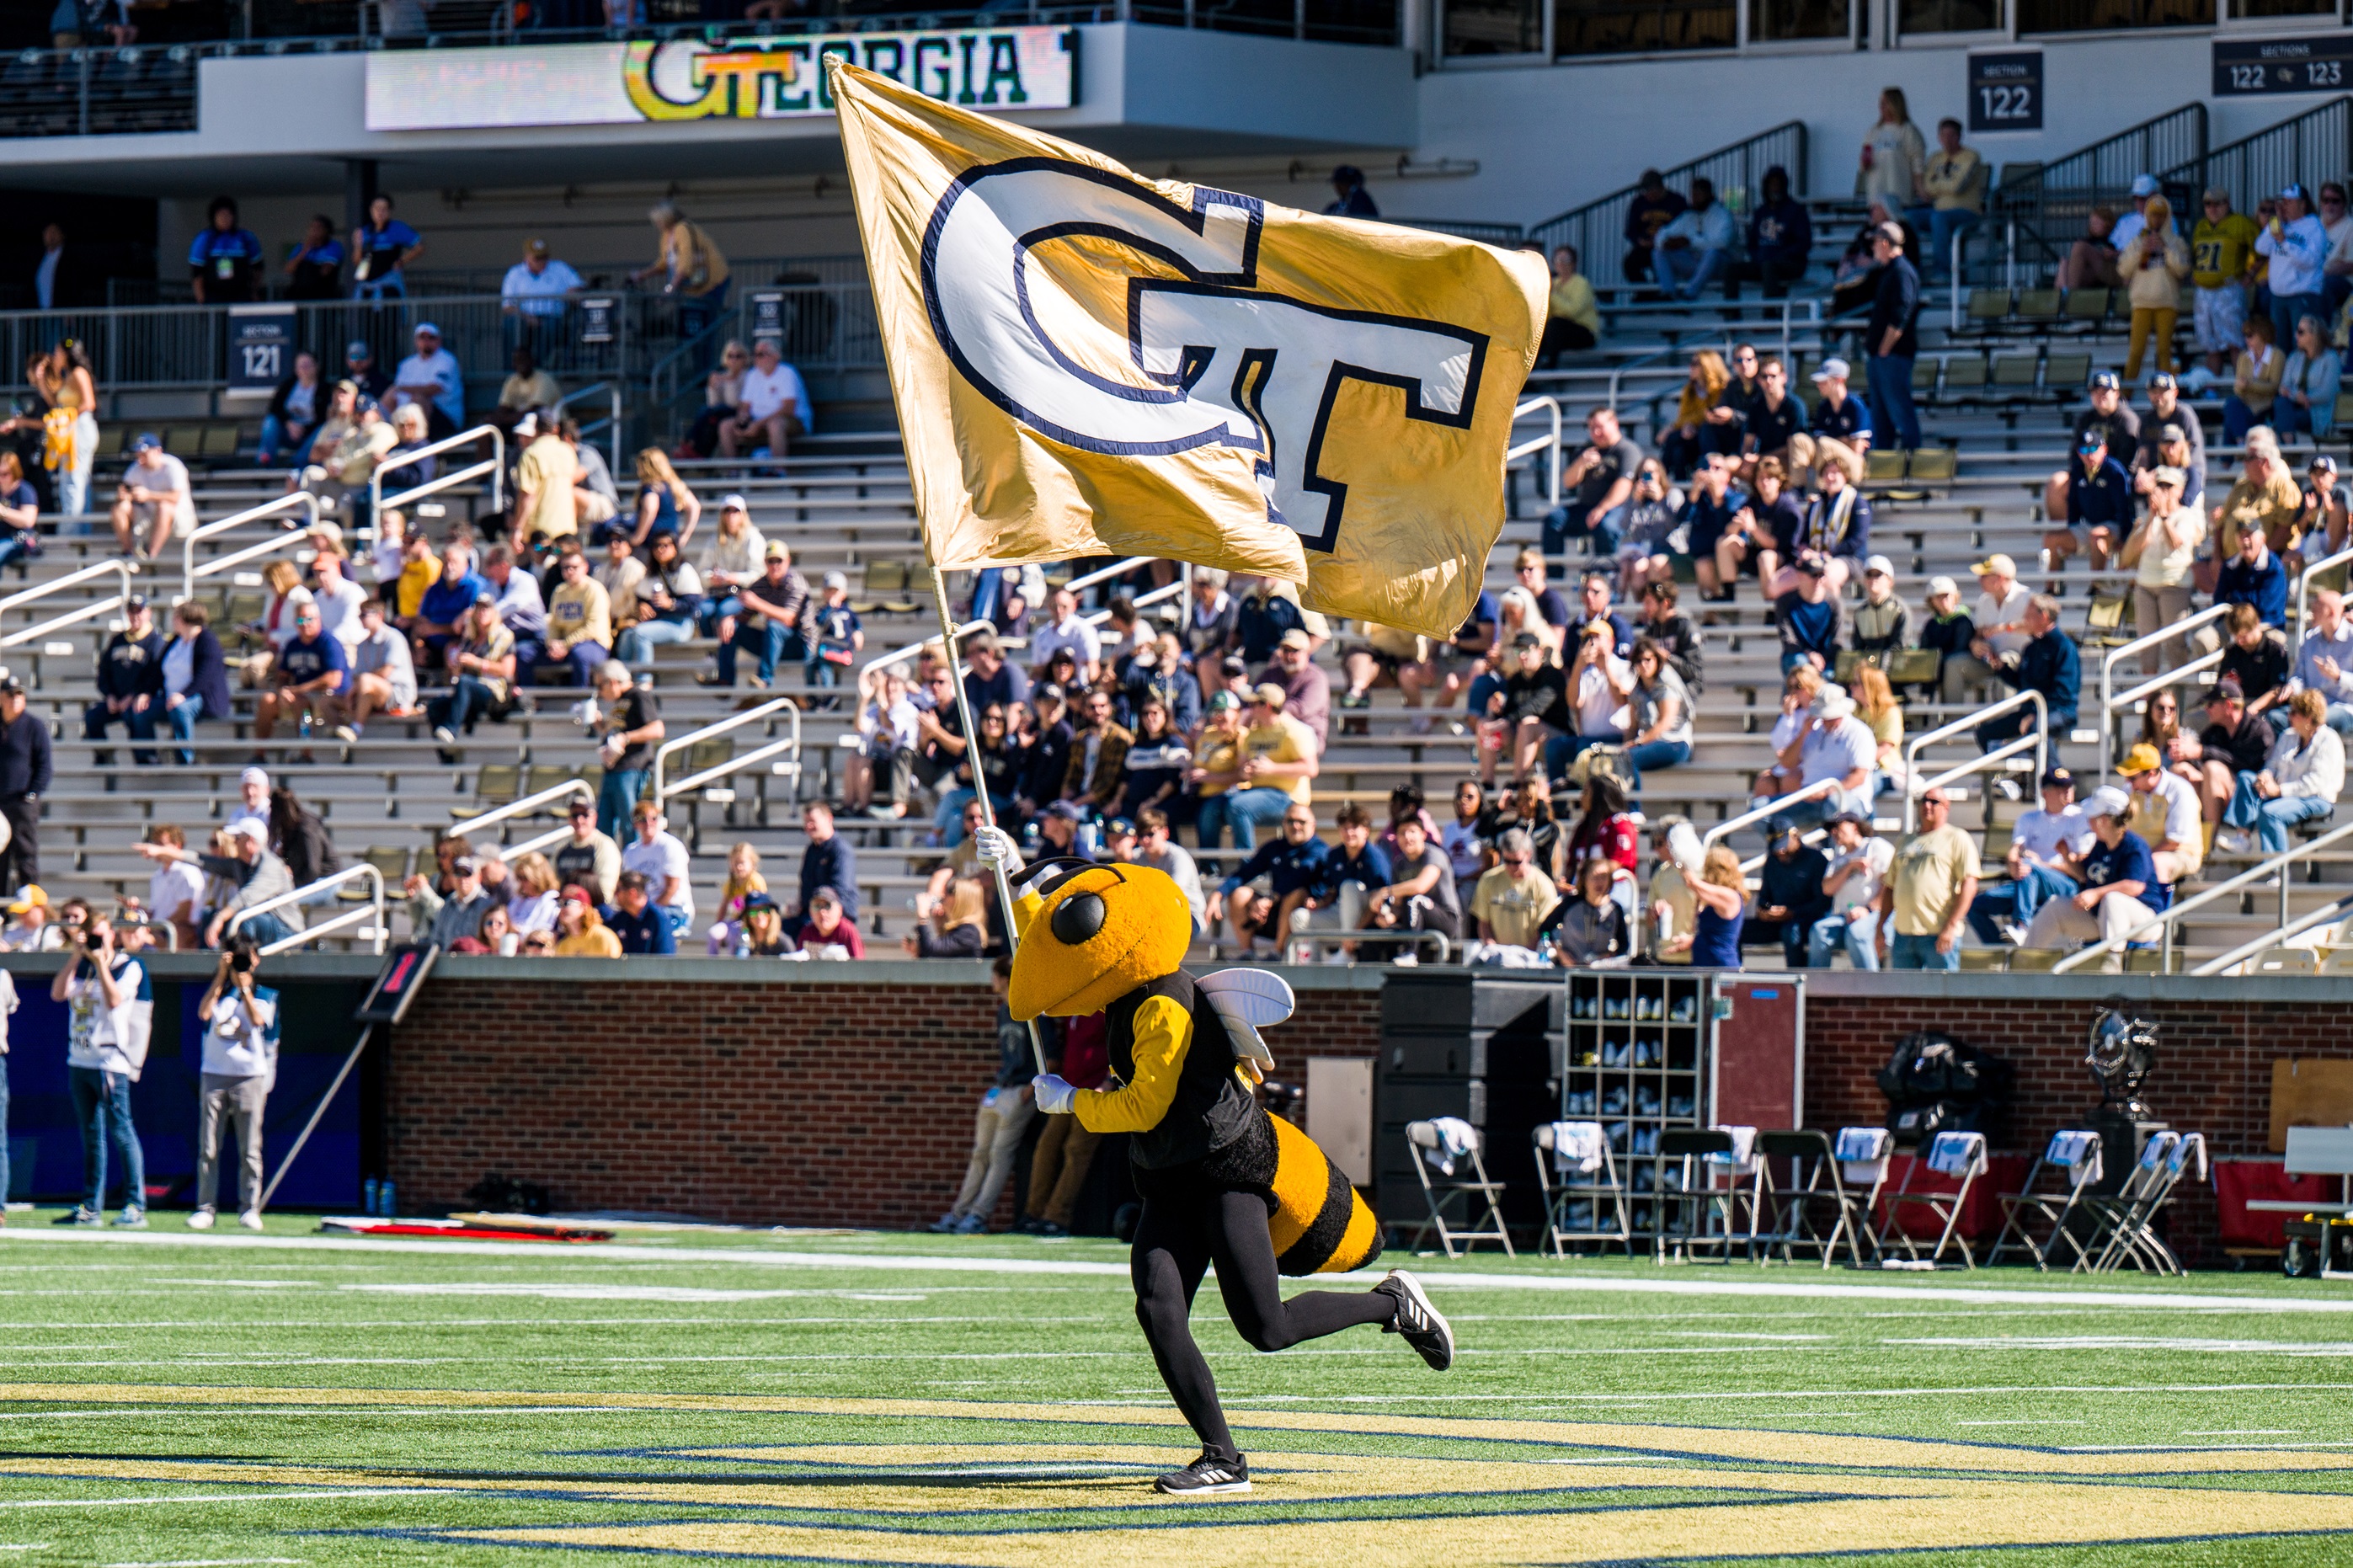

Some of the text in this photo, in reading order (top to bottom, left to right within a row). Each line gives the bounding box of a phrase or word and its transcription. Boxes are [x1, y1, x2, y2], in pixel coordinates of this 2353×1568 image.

[2260, 44, 2311, 58] SECTIONS
[1982, 63, 2029, 77] SECTION
[2231, 64, 2266, 89] 122
[2307, 60, 2343, 85] 123
[1980, 86, 2030, 120] 122
[2195, 239, 2223, 272] 21
[241, 344, 280, 378] 121
